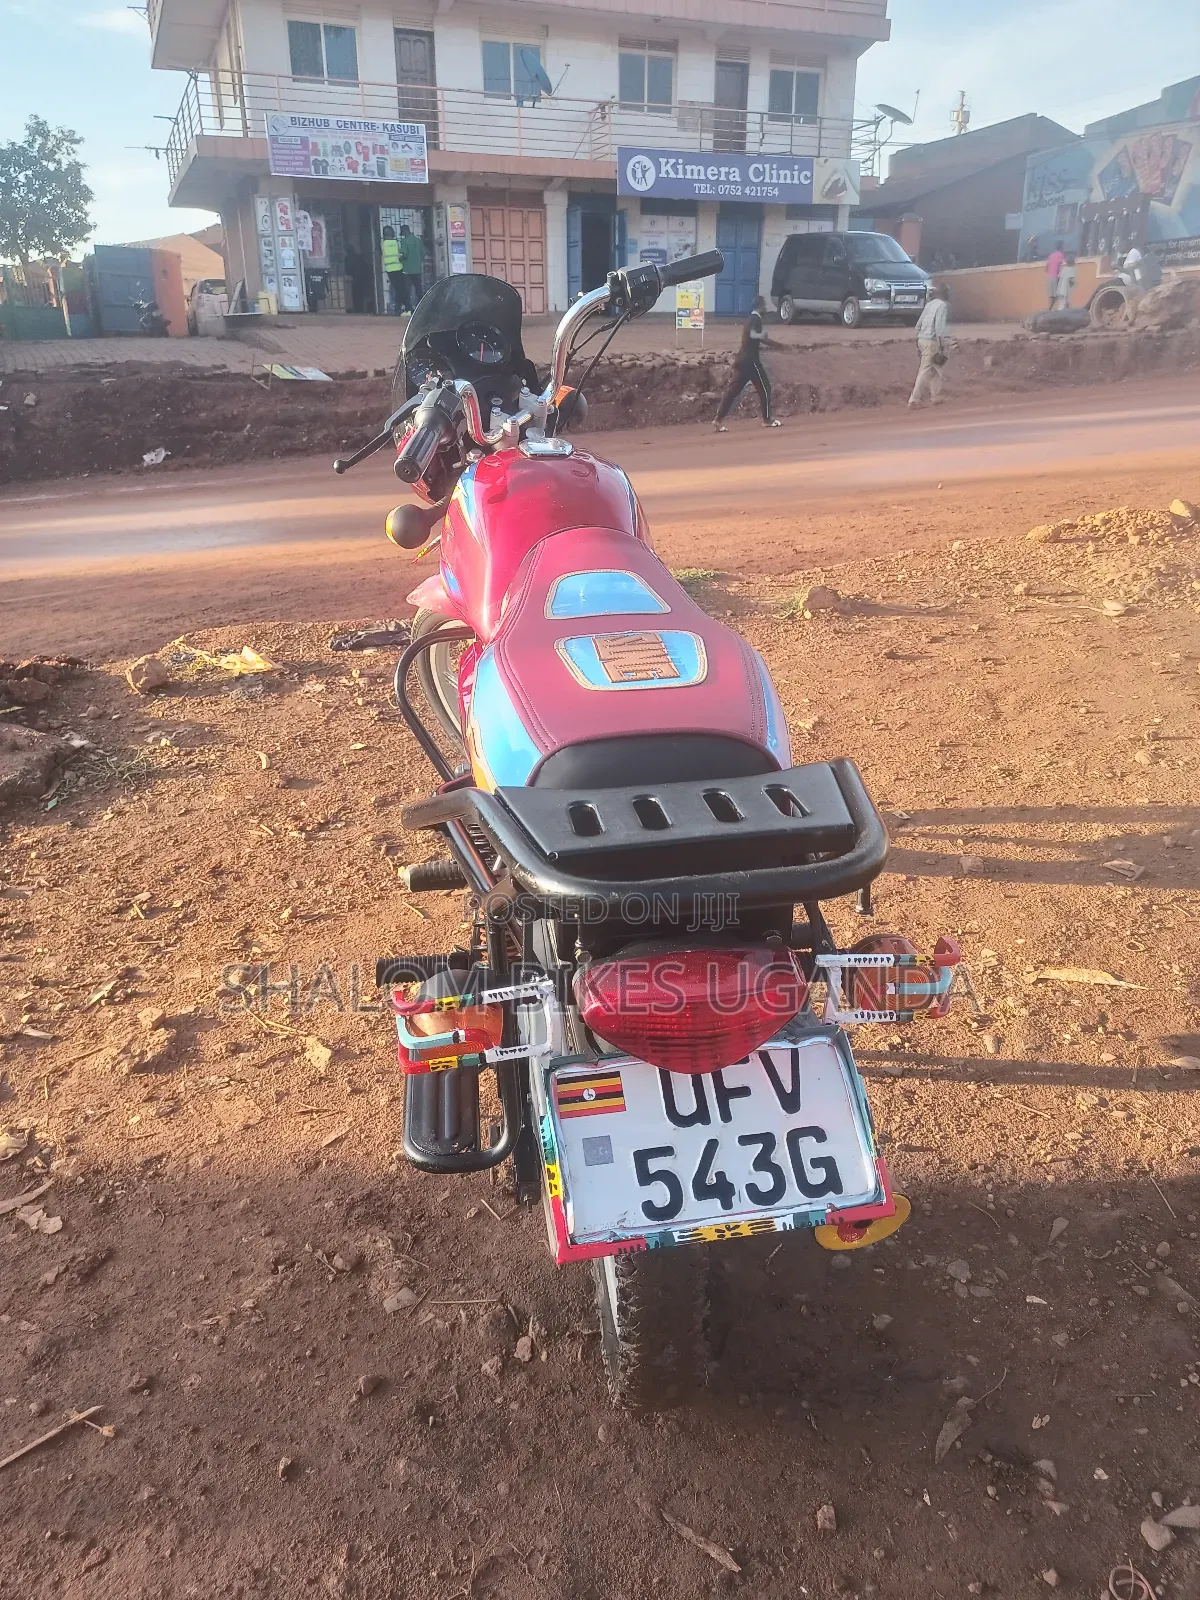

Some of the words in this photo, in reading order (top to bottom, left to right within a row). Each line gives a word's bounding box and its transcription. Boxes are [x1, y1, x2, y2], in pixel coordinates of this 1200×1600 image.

[290, 116, 331, 128] BIZHUB
[382, 123, 420, 135] KASUBI
[658, 157, 741, 182] Kimera
[748, 163, 811, 185] Clinic
[694, 184, 715, 194] TEL:
[718, 185, 742, 196] 0752
[745, 186, 779, 197] 421754
[656, 1046, 801, 1128] UFV
[632, 1125, 844, 1222] 543G
